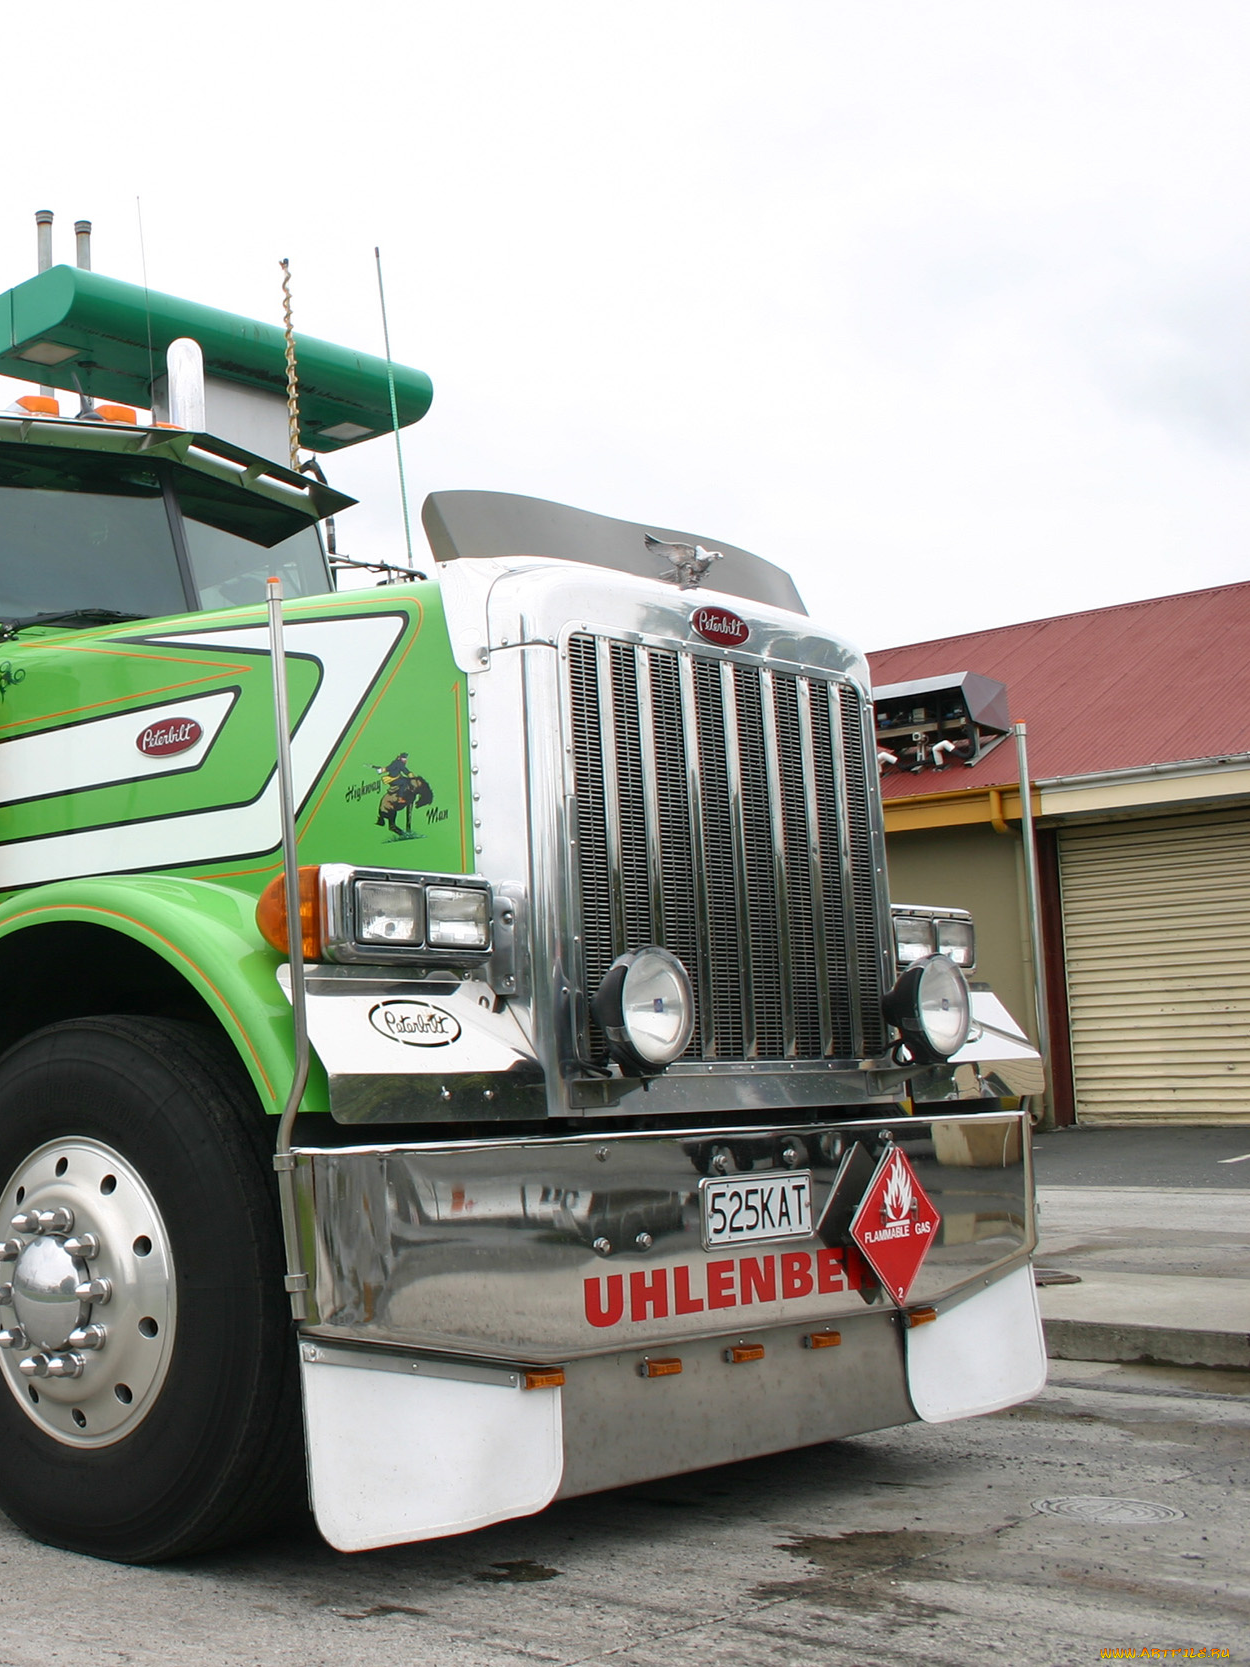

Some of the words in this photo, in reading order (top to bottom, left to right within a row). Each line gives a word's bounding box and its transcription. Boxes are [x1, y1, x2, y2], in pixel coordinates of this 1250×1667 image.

[699, 610, 745, 637] Peterbilt
[142, 722, 196, 751] Peterbilt
[345, 780, 382, 802] Highway
[426, 806, 449, 825] Man
[384, 1011, 450, 1034] Peterbilt
[711, 1184, 806, 1234] 525KAT
[864, 1225, 910, 1245] FLAMMABLE
[914, 1221, 931, 1235] GAS
[897, 1286, 904, 1299] 2
